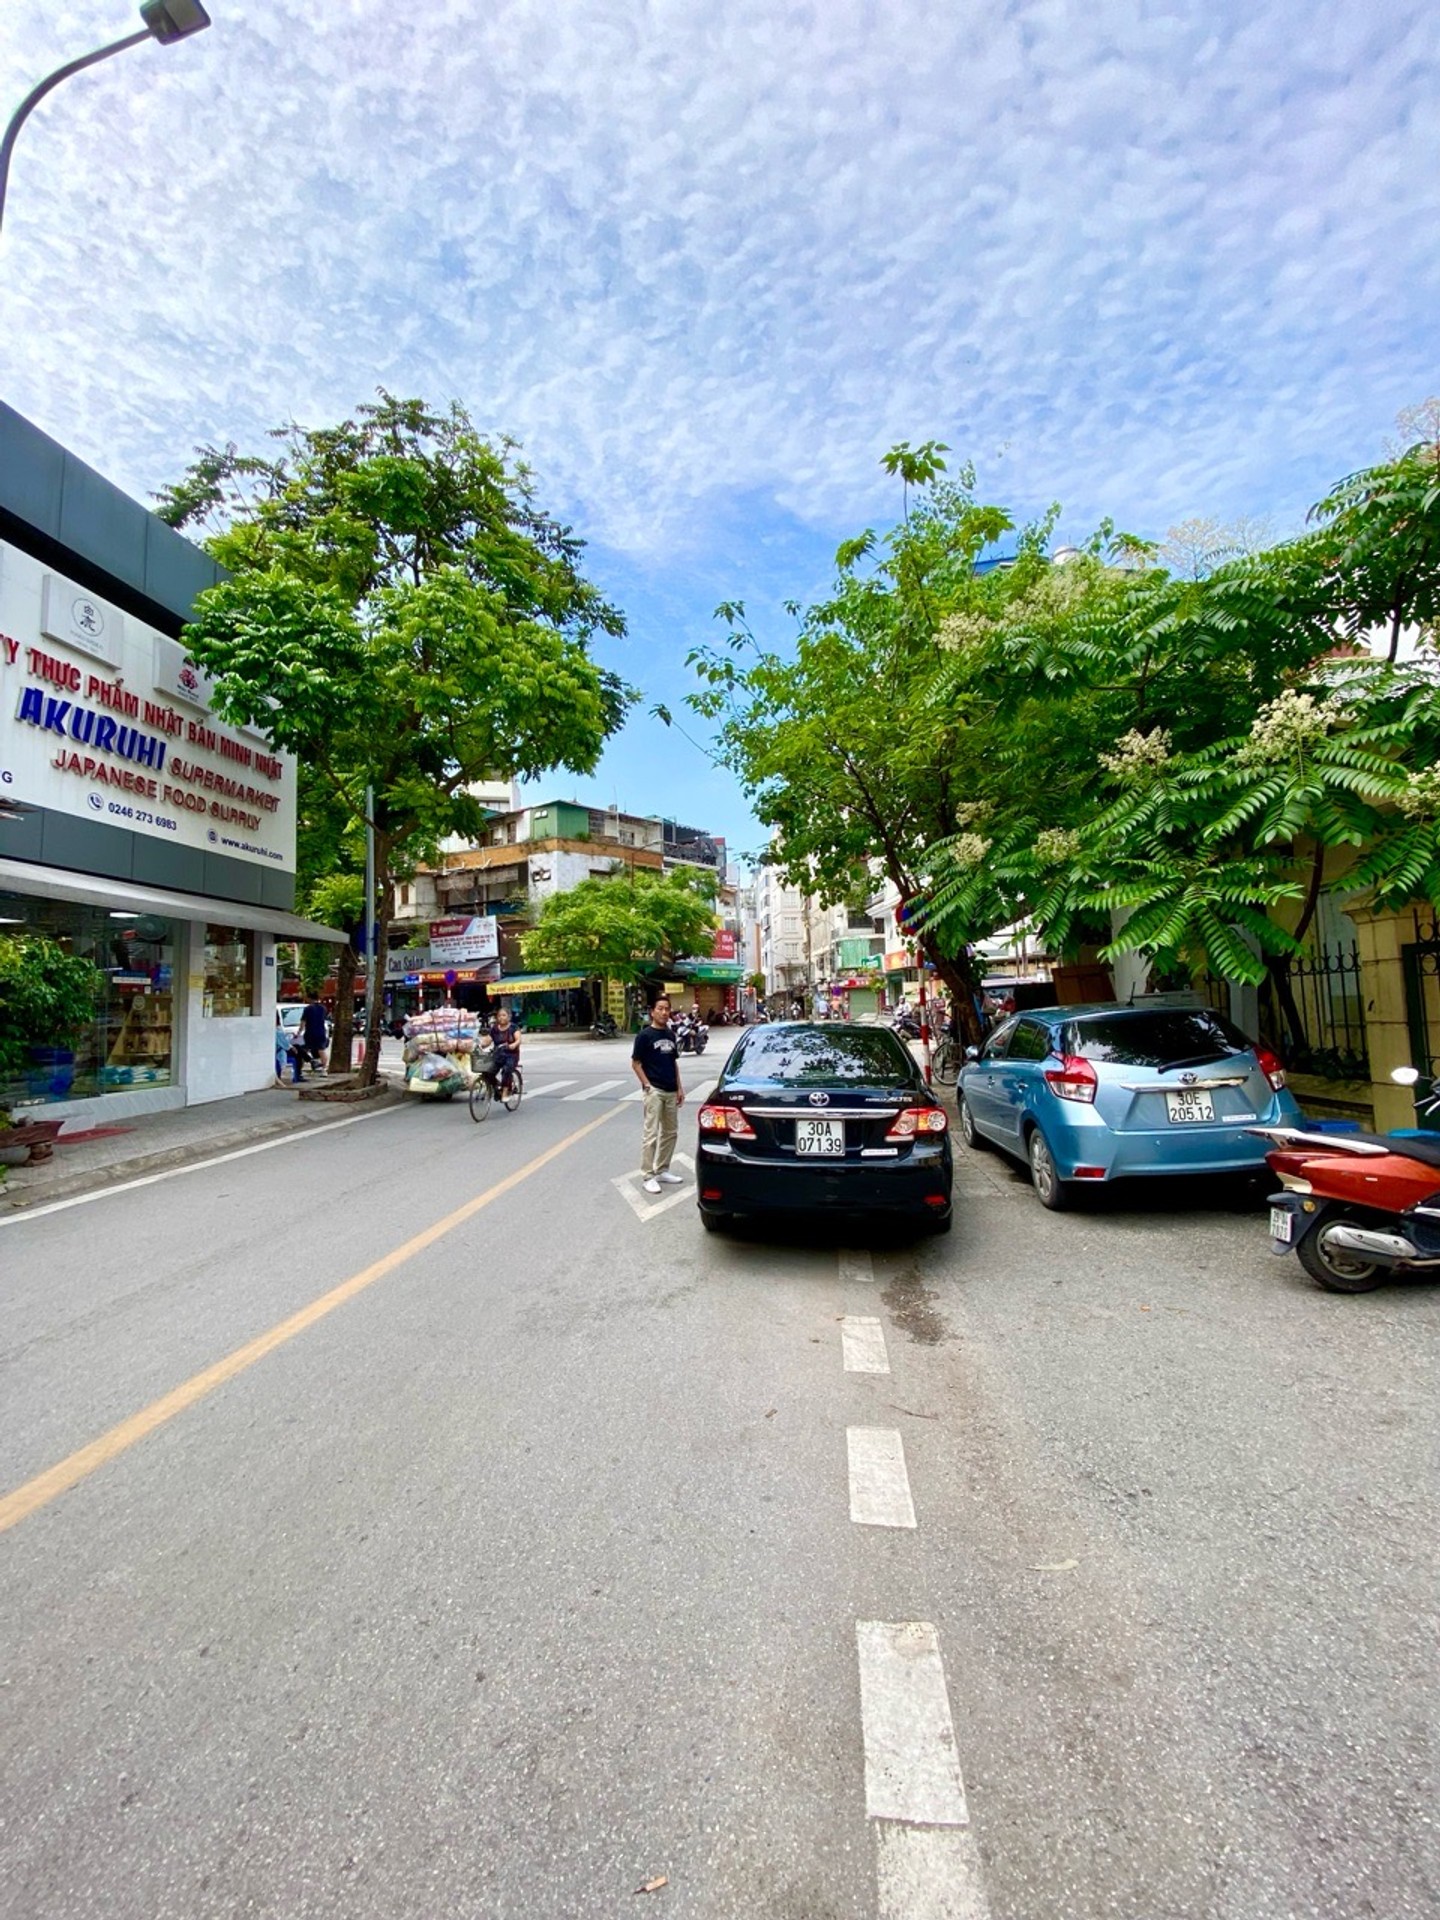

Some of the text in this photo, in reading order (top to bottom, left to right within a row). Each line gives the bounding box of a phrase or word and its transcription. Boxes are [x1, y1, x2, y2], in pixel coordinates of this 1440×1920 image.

[28, 648, 82, 692] THỰC
[86, 677, 140, 718] PHẨM
[143, 701, 184, 737] NHẬT
[187, 718, 216, 751] BẢN
[219, 736, 252, 766] MINH
[254, 751, 283, 780] NHẬT
[17, 687, 281, 813] AKURUHI SUPERMARKET
[54, 748, 262, 832] JAPANESE FOOD SUPPLY
[108, 802, 177, 831] 0246 273 6983
[221, 837, 283, 861] www.akuruhi.com
[1177, 1092, 1202, 1106] 30E
[1170, 1106, 1214, 1122] 205.12
[807, 1121, 832, 1136] 30A
[798, 1138, 842, 1154] 071.39
